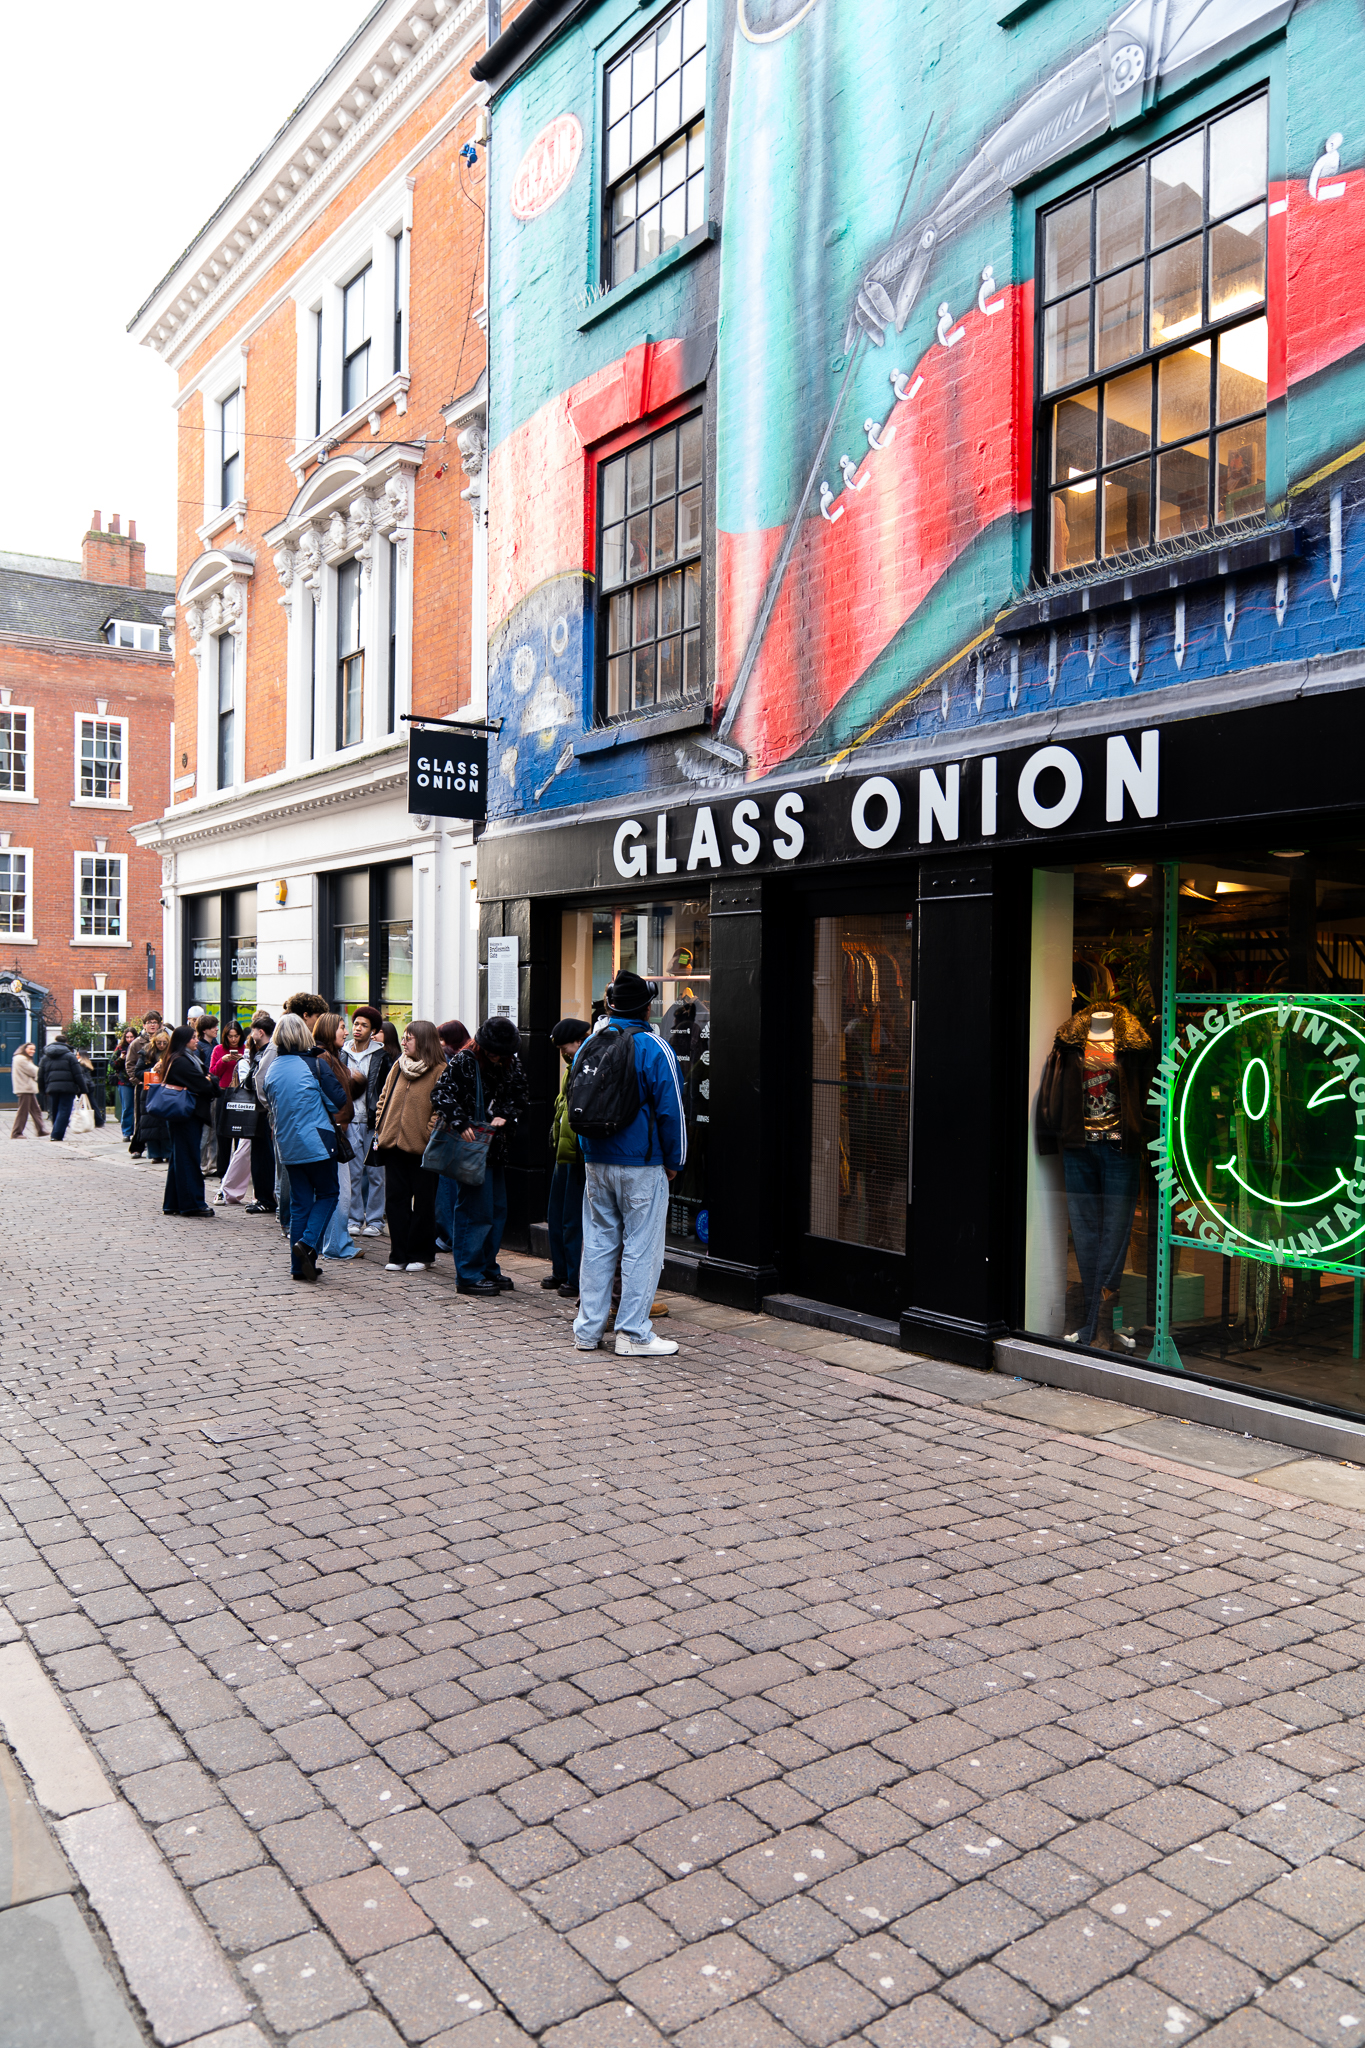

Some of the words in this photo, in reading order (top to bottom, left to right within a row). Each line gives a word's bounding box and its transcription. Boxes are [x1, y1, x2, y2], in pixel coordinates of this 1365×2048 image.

[416, 773, 479, 793] ONION
[417, 756, 479, 777] GLASS
[613, 791, 805, 879] GLASS
[851, 729, 1160, 850] ONION
[1147, 1001, 1243, 1106] VINTAGE
[1146, 1136, 1238, 1258] VINTAGE
